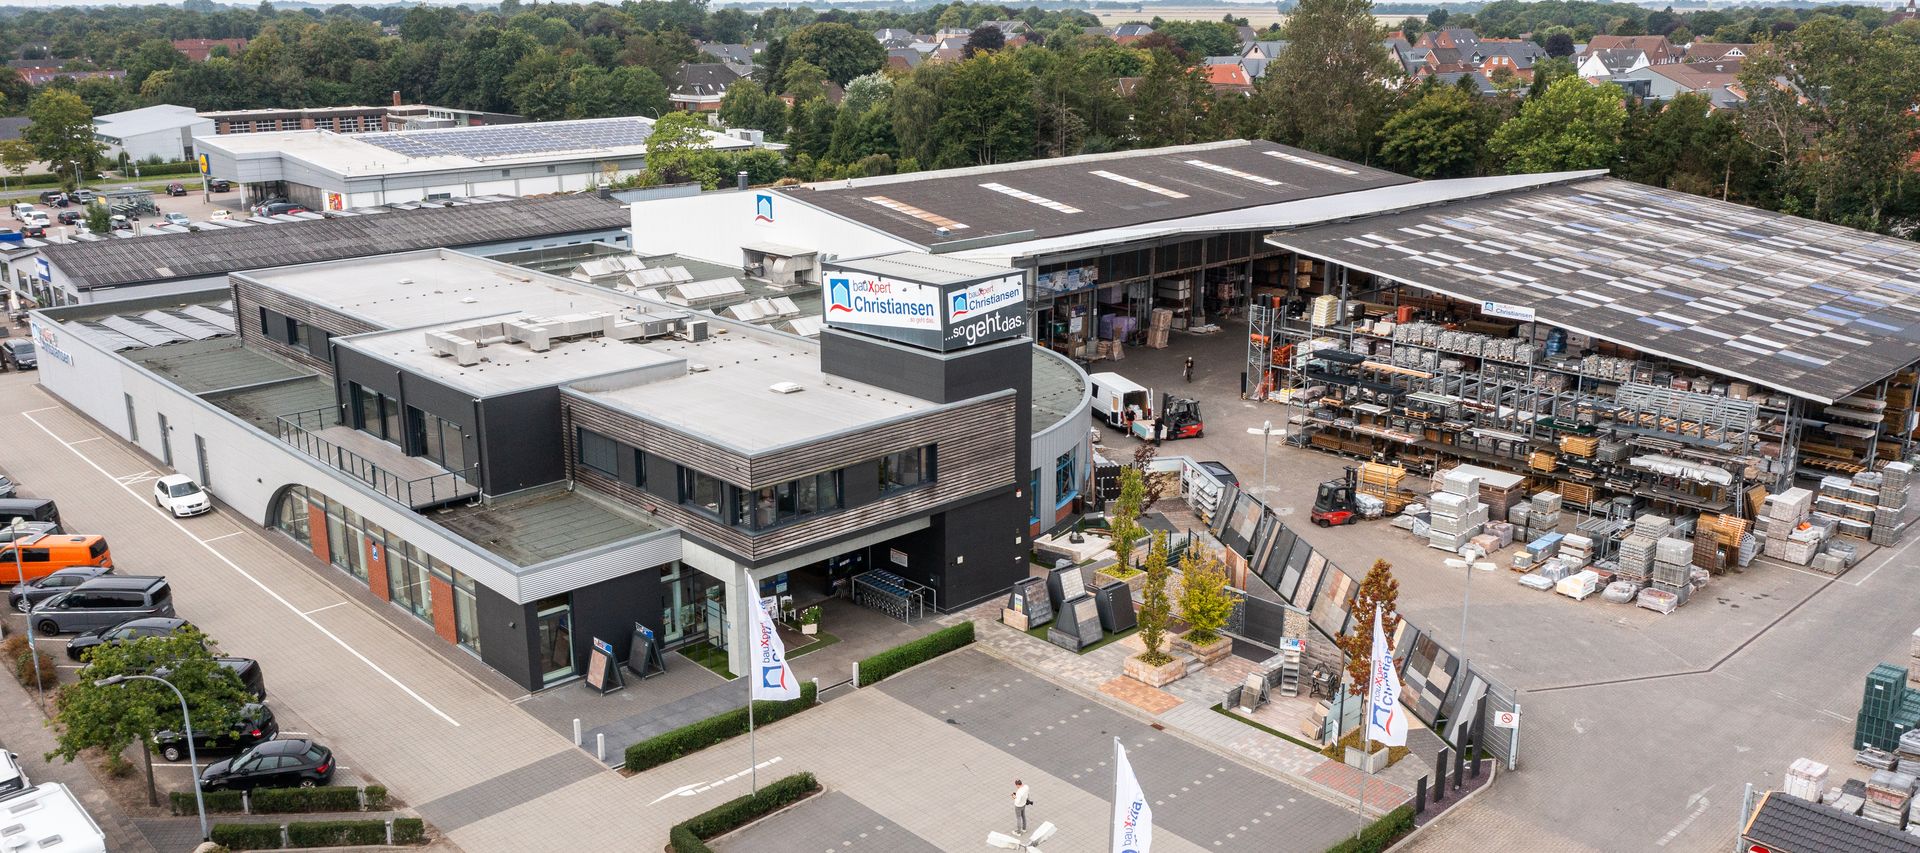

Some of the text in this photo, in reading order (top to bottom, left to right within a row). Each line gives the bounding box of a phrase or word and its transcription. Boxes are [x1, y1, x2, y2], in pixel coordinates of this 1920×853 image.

[854, 296, 934, 316] Christiansen
[969, 288, 1020, 311] Christiansen
[966, 311, 1001, 346] geht
[1001, 315, 1025, 332] das.
